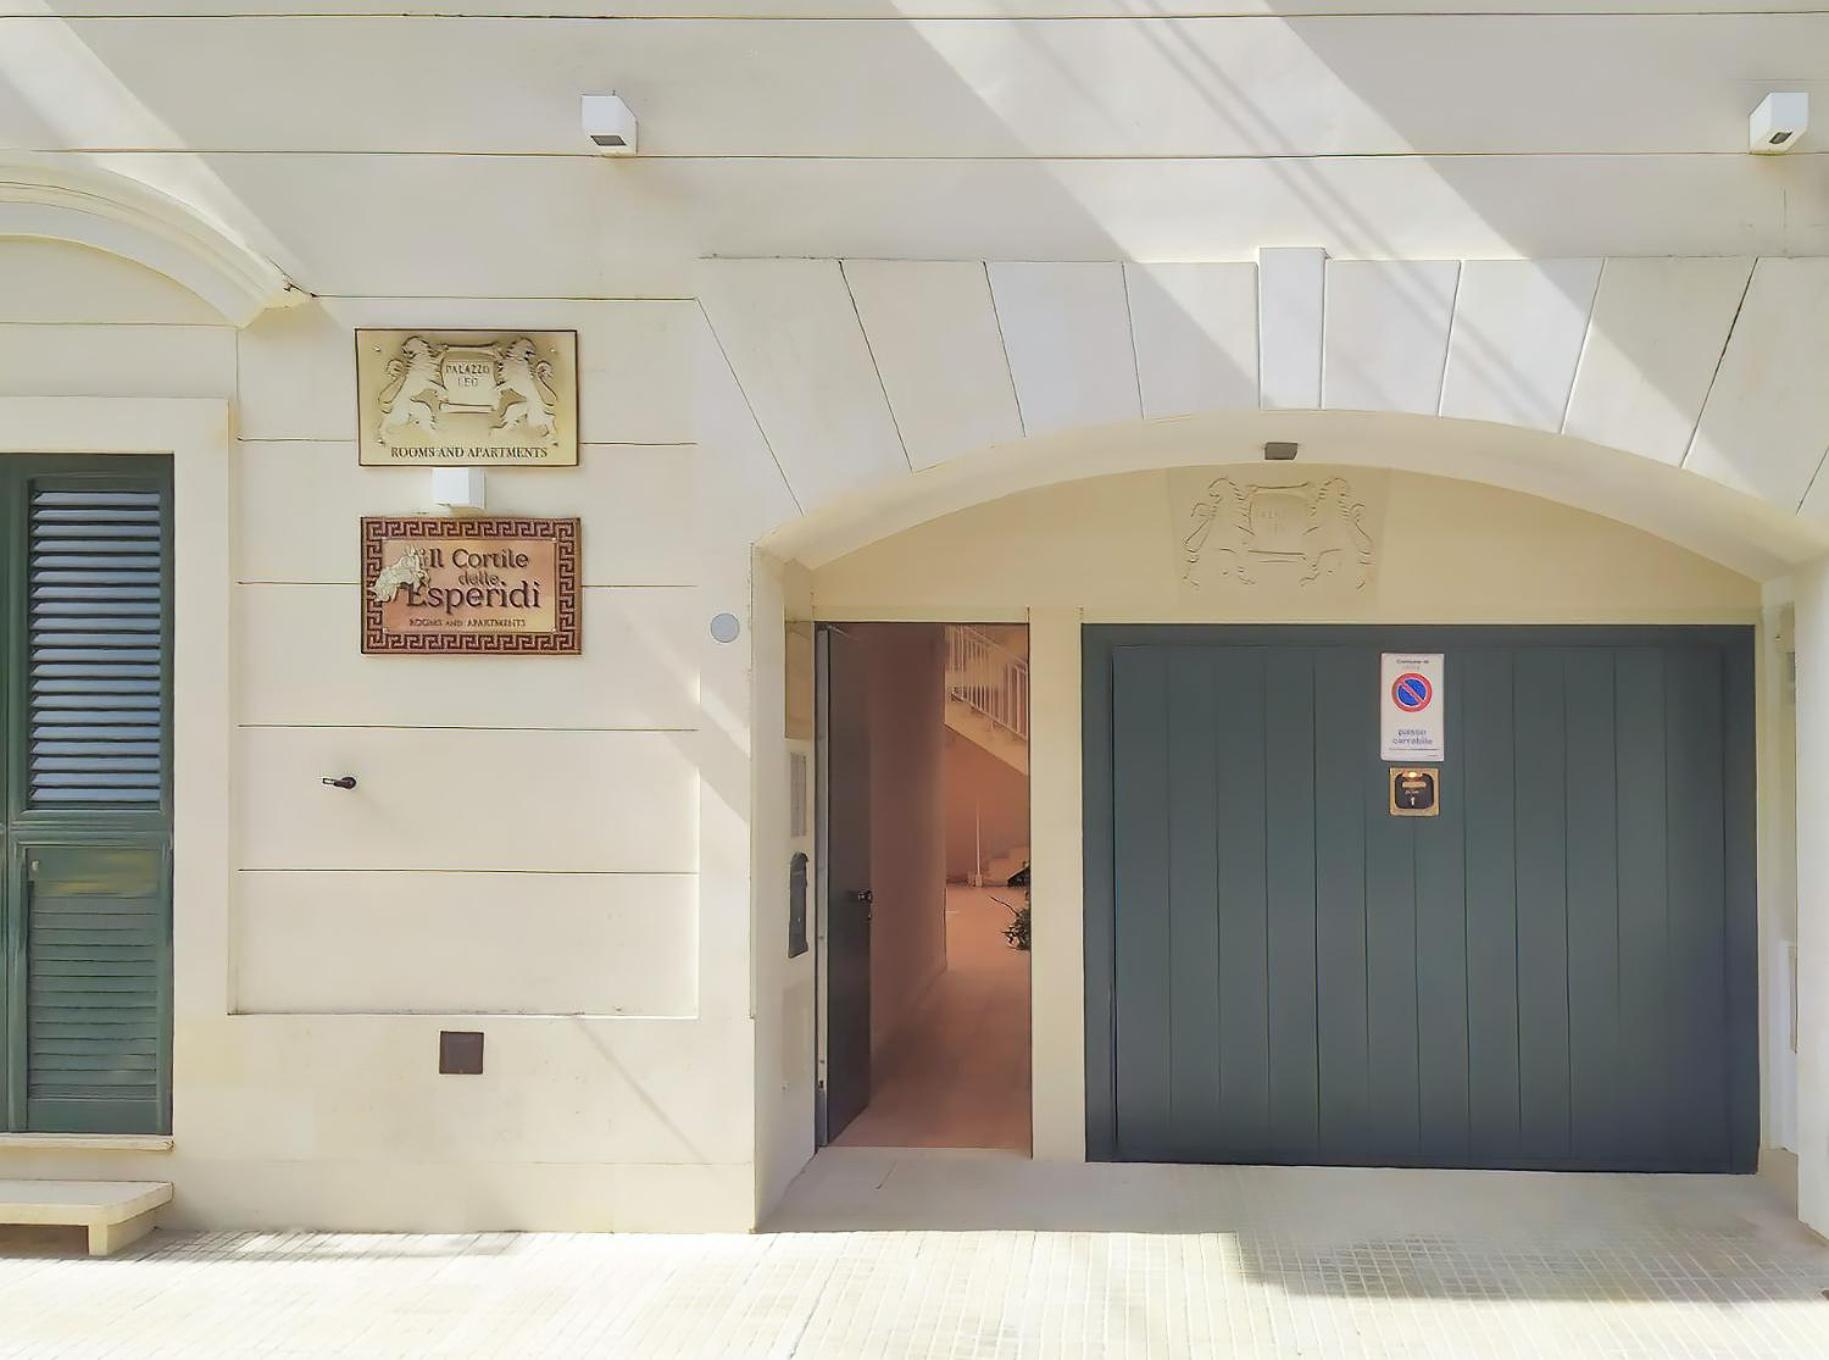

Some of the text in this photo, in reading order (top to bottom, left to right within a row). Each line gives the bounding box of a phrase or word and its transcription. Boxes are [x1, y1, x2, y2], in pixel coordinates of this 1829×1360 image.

[446, 364, 490, 374] PALAZZO
[457, 377, 479, 387] LEO
[390, 446, 548, 458] ROOMS AND APARTMENTS
[429, 548, 529, 569] Il Cortile
[458, 570, 500, 586] delle
[406, 580, 541, 615] Esperidi
[466, 619, 527, 627] APARTMENTS
